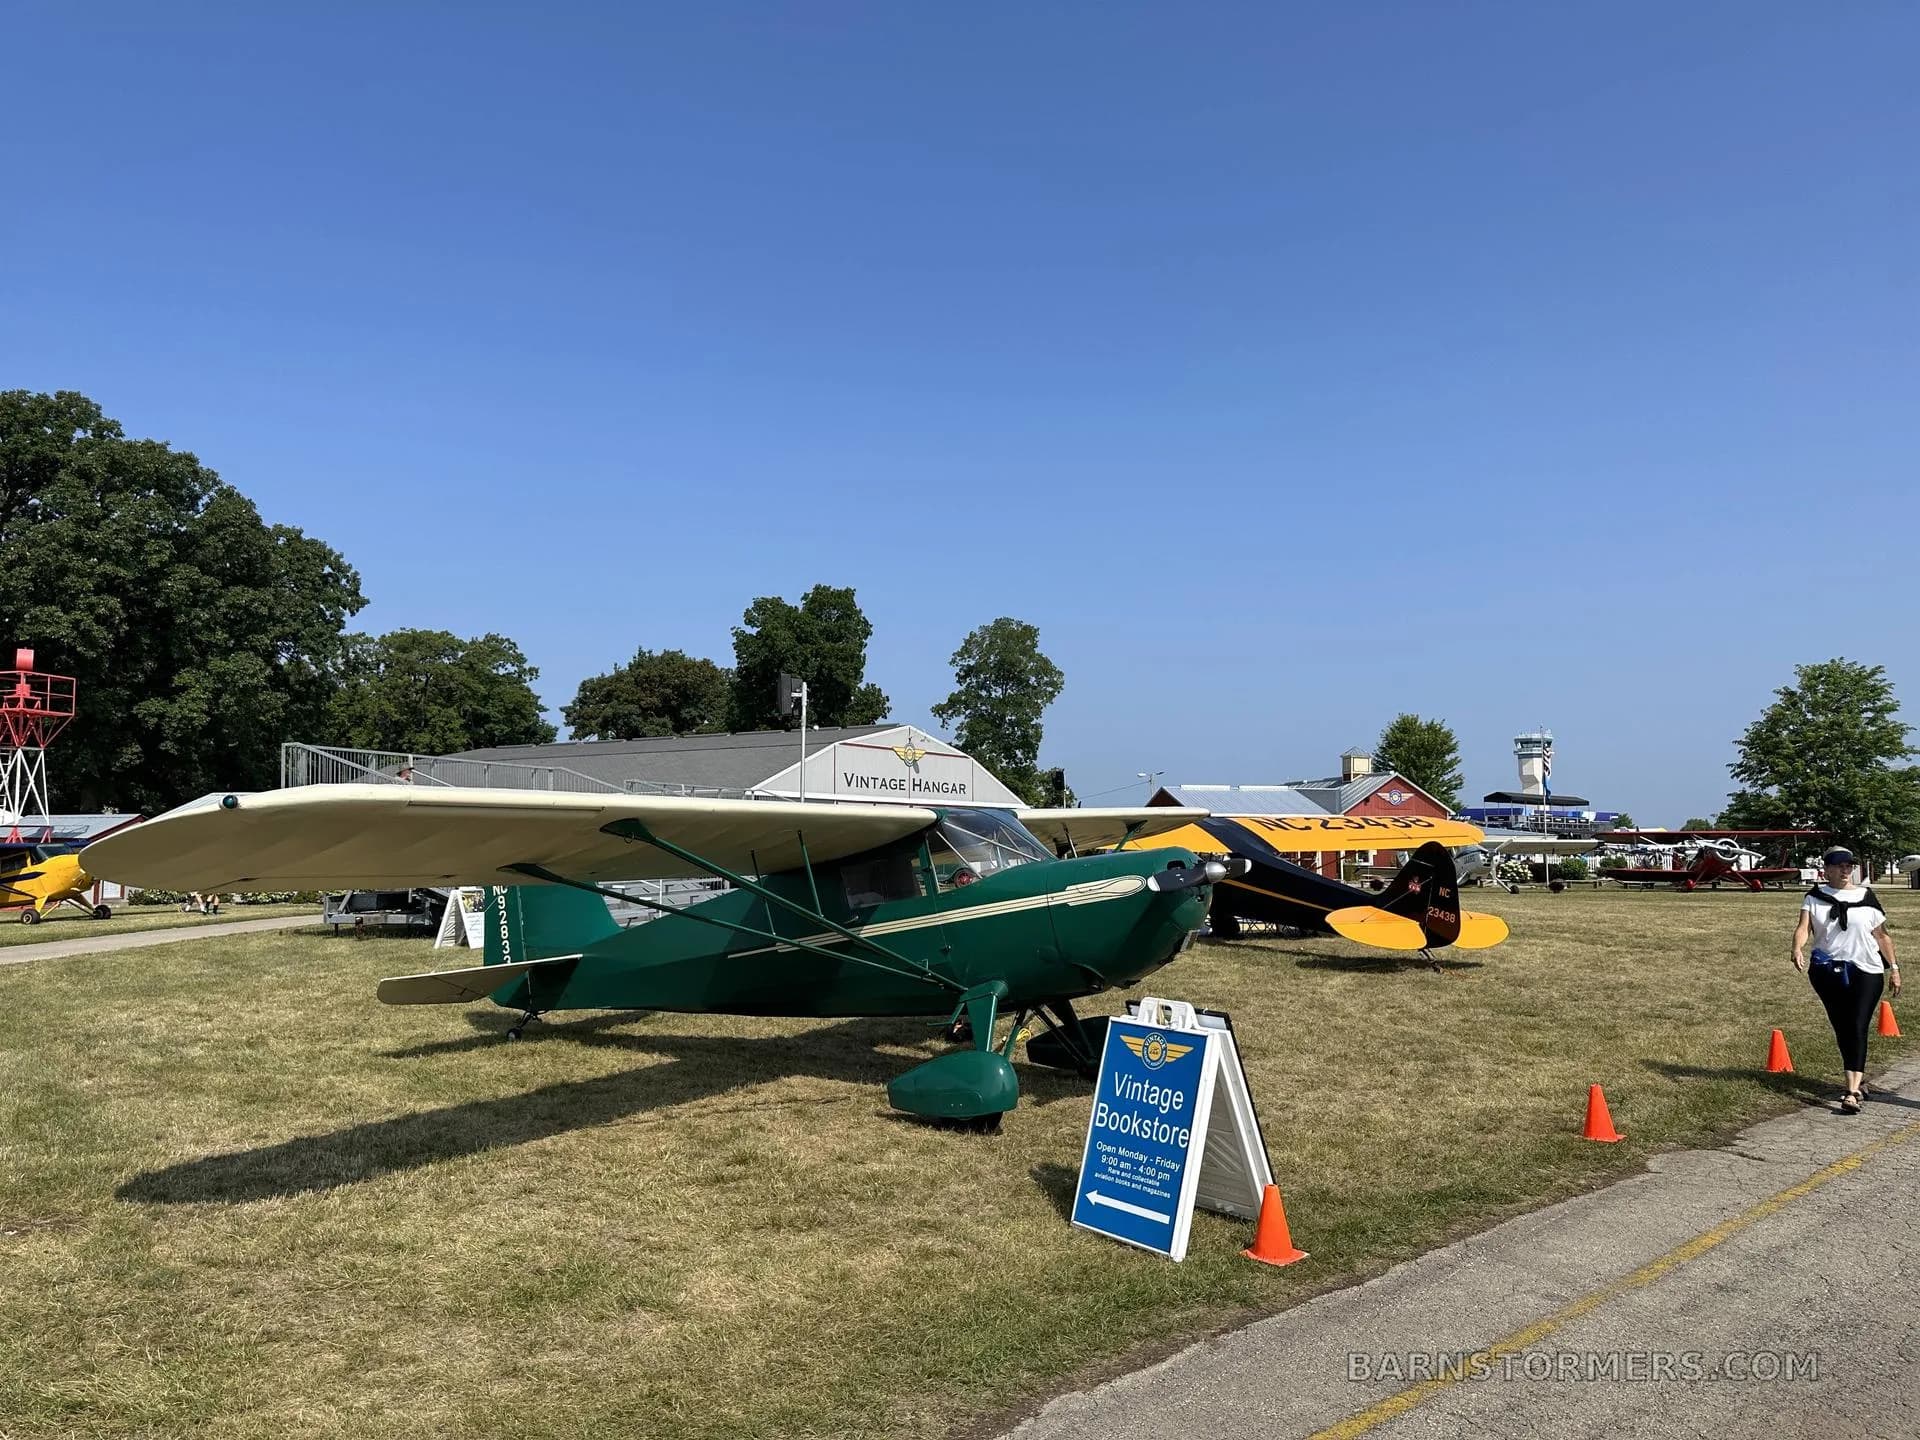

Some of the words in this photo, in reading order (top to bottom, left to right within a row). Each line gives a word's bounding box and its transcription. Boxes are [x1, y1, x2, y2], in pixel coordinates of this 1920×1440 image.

[844, 773, 906, 791] VINTAGE
[912, 778, 967, 795] HANGAR
[1439, 886, 1451, 898] NC
[1428, 906, 1456, 923] 23438
[1115, 1071, 1184, 1114] Vintage
[1095, 1102, 1190, 1149] Bookstore
[1096, 1140, 1116, 1152] Open
[1117, 1146, 1148, 1164] Monday
[1155, 1156, 1181, 1172] Friday
[1101, 1154, 1118, 1166] 9:00
[1119, 1161, 1132, 1170] am
[1138, 1165, 1156, 1177] 4:00
[1157, 1171, 1170, 1181] pm
[1094, 1172, 1115, 1182] aviation
[1115, 1177, 1131, 1187] books
[1142, 1187, 1171, 1199] magazines
[1108, 1166, 1121, 1175] Rare
[1121, 1171, 1132, 1179] and
